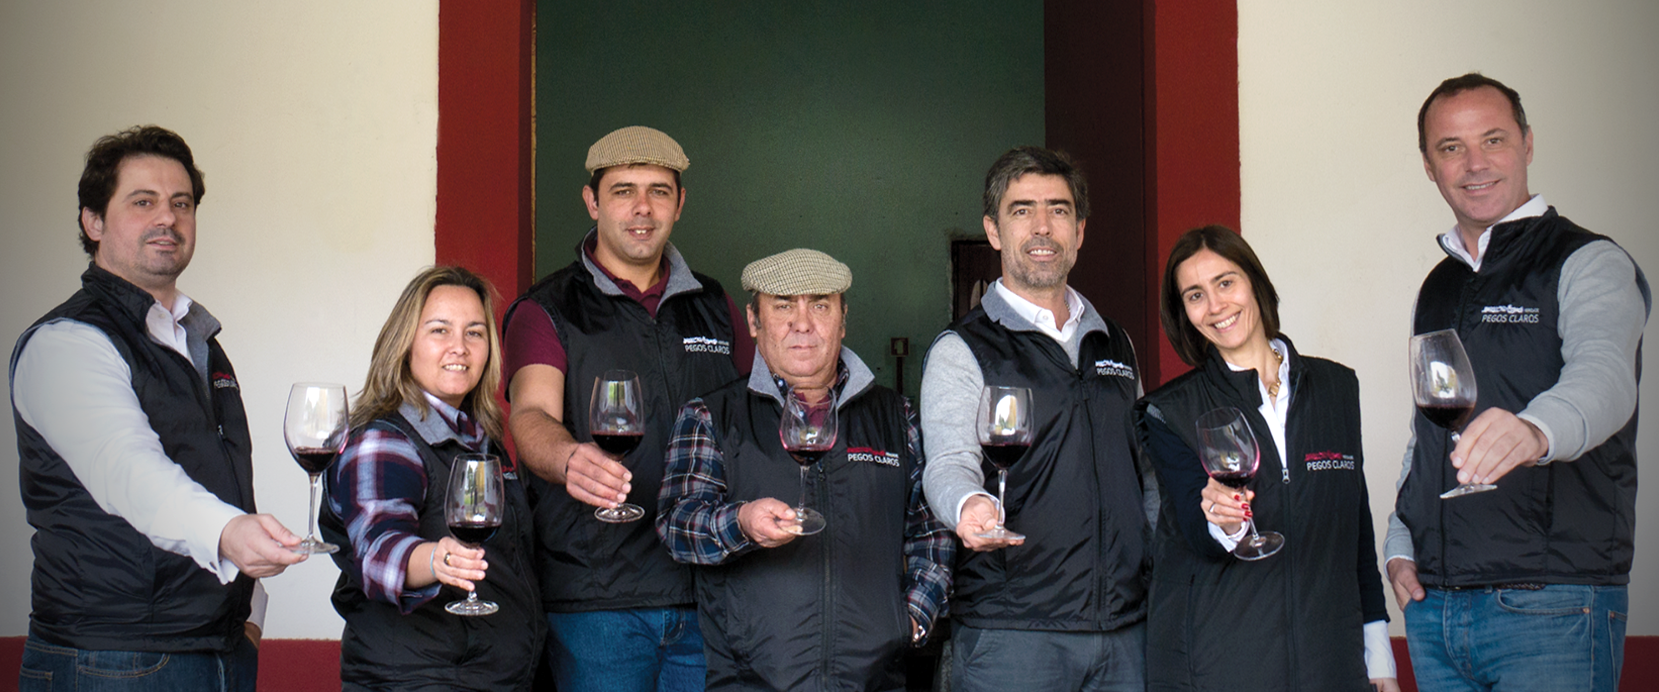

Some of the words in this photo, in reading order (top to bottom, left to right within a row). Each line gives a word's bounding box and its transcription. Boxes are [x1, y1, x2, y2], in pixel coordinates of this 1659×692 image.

[1482, 313, 1508, 324] PEGOS
[1509, 313, 1540, 324] CLAROS
[847, 453, 874, 462] PEGOS
[874, 455, 900, 467] CLAROS
[1306, 460, 1332, 471] PEGOS
[1332, 460, 1355, 470] CLAROS
